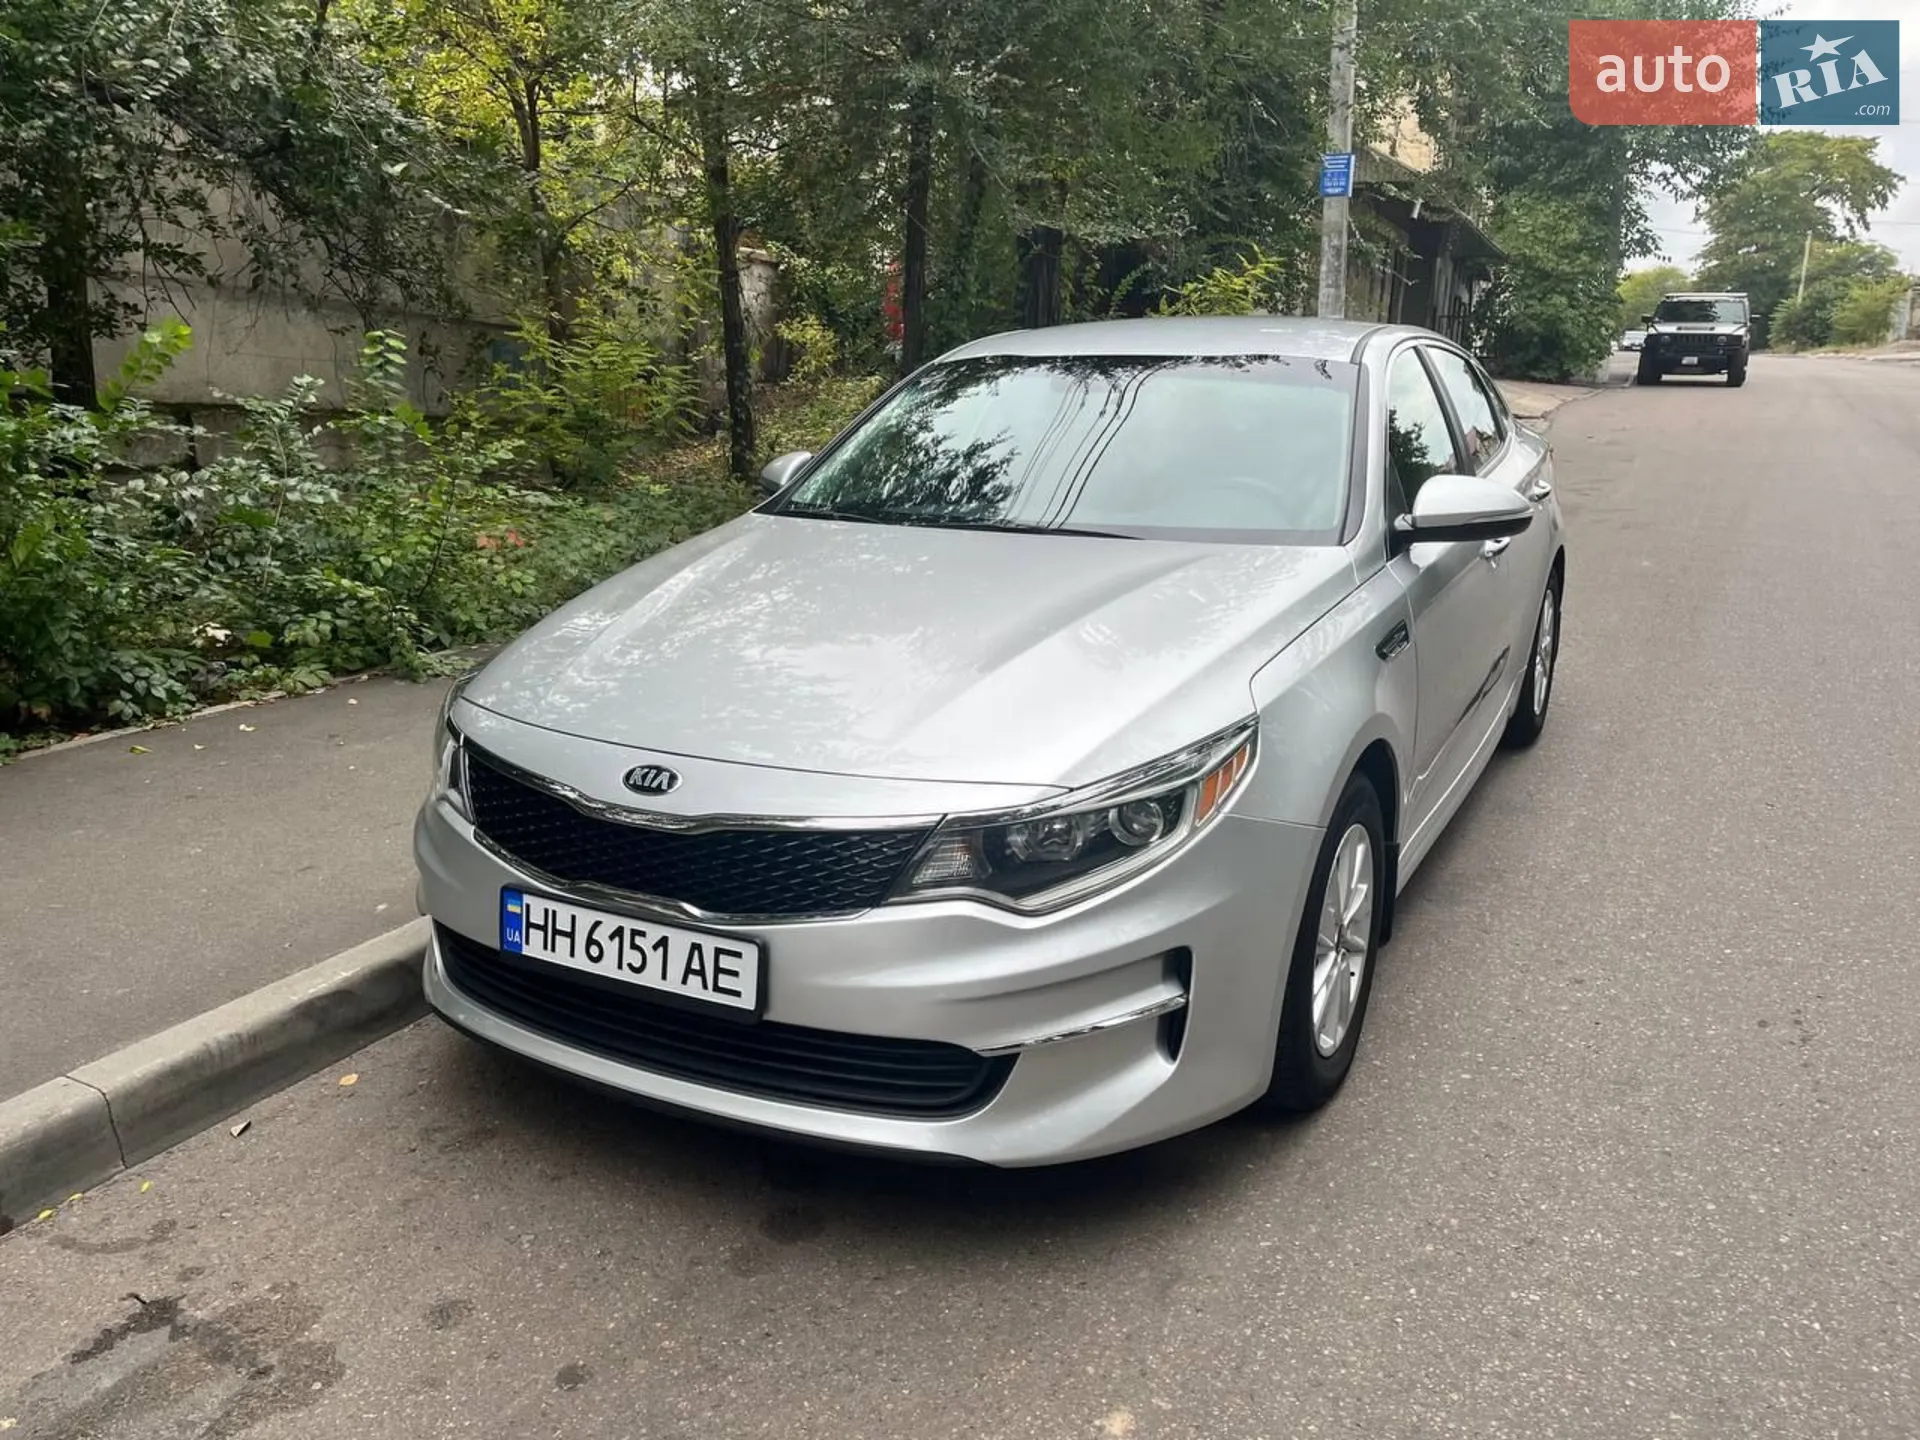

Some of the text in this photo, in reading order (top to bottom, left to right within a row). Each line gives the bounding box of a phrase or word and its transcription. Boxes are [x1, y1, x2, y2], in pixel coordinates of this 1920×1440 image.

[628, 767, 670, 790] KIA
[506, 927, 521, 944] UA
[524, 903, 743, 998] HH 6151 AE
